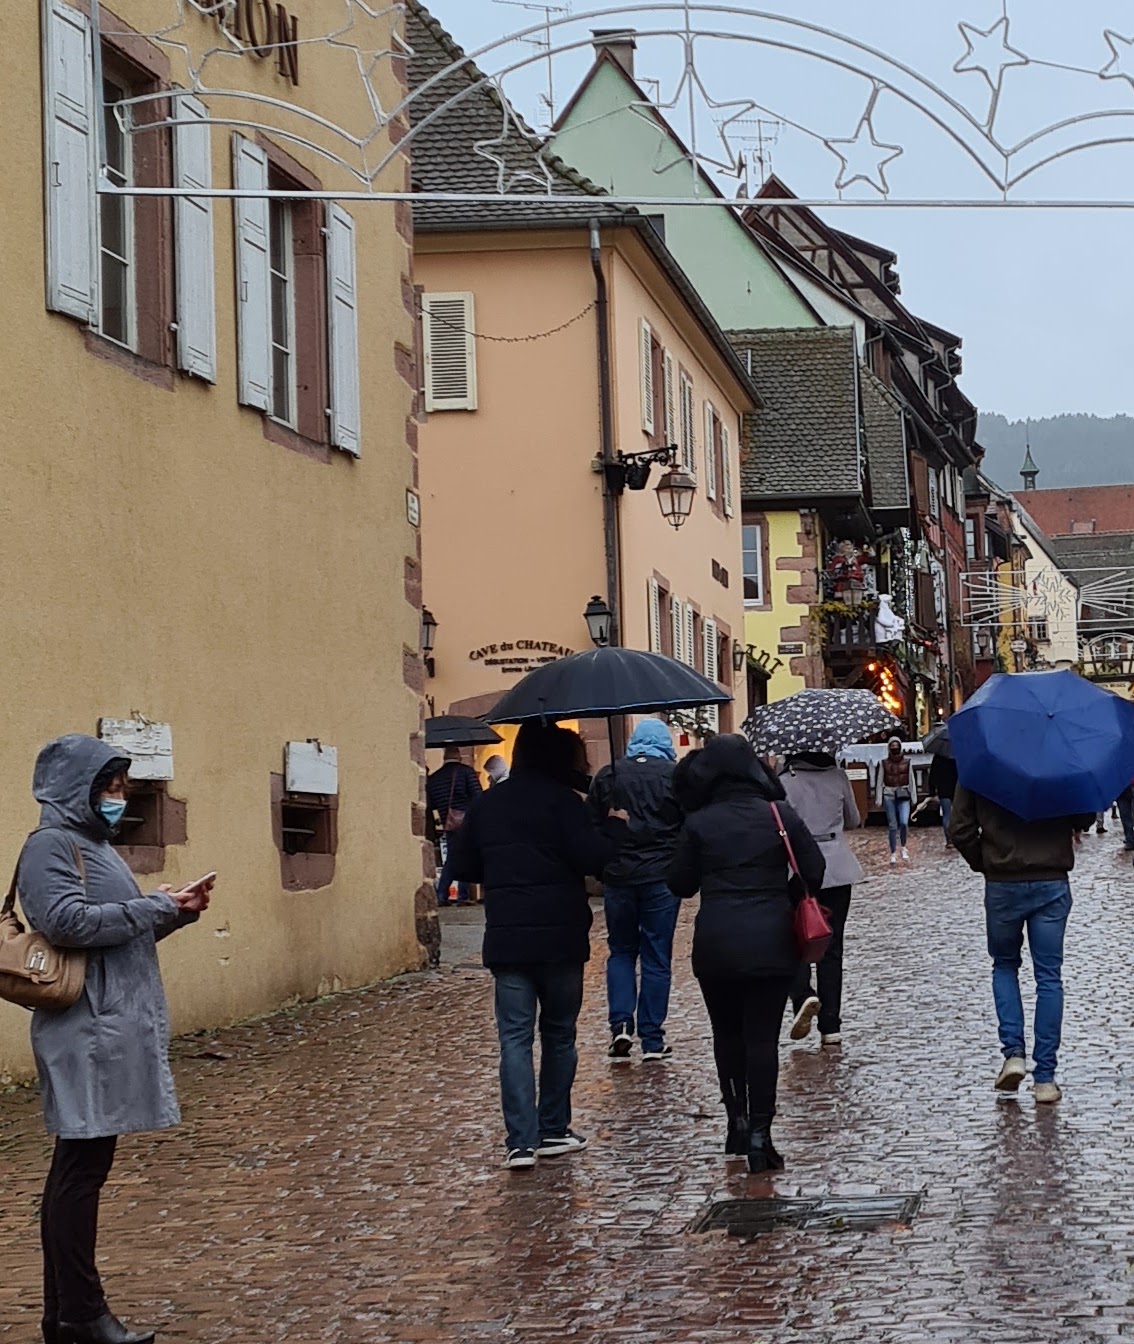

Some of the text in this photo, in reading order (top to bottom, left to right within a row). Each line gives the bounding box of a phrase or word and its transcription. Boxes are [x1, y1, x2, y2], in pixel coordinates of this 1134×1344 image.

[468, 640, 577, 661] CAVE du CHATEAU
